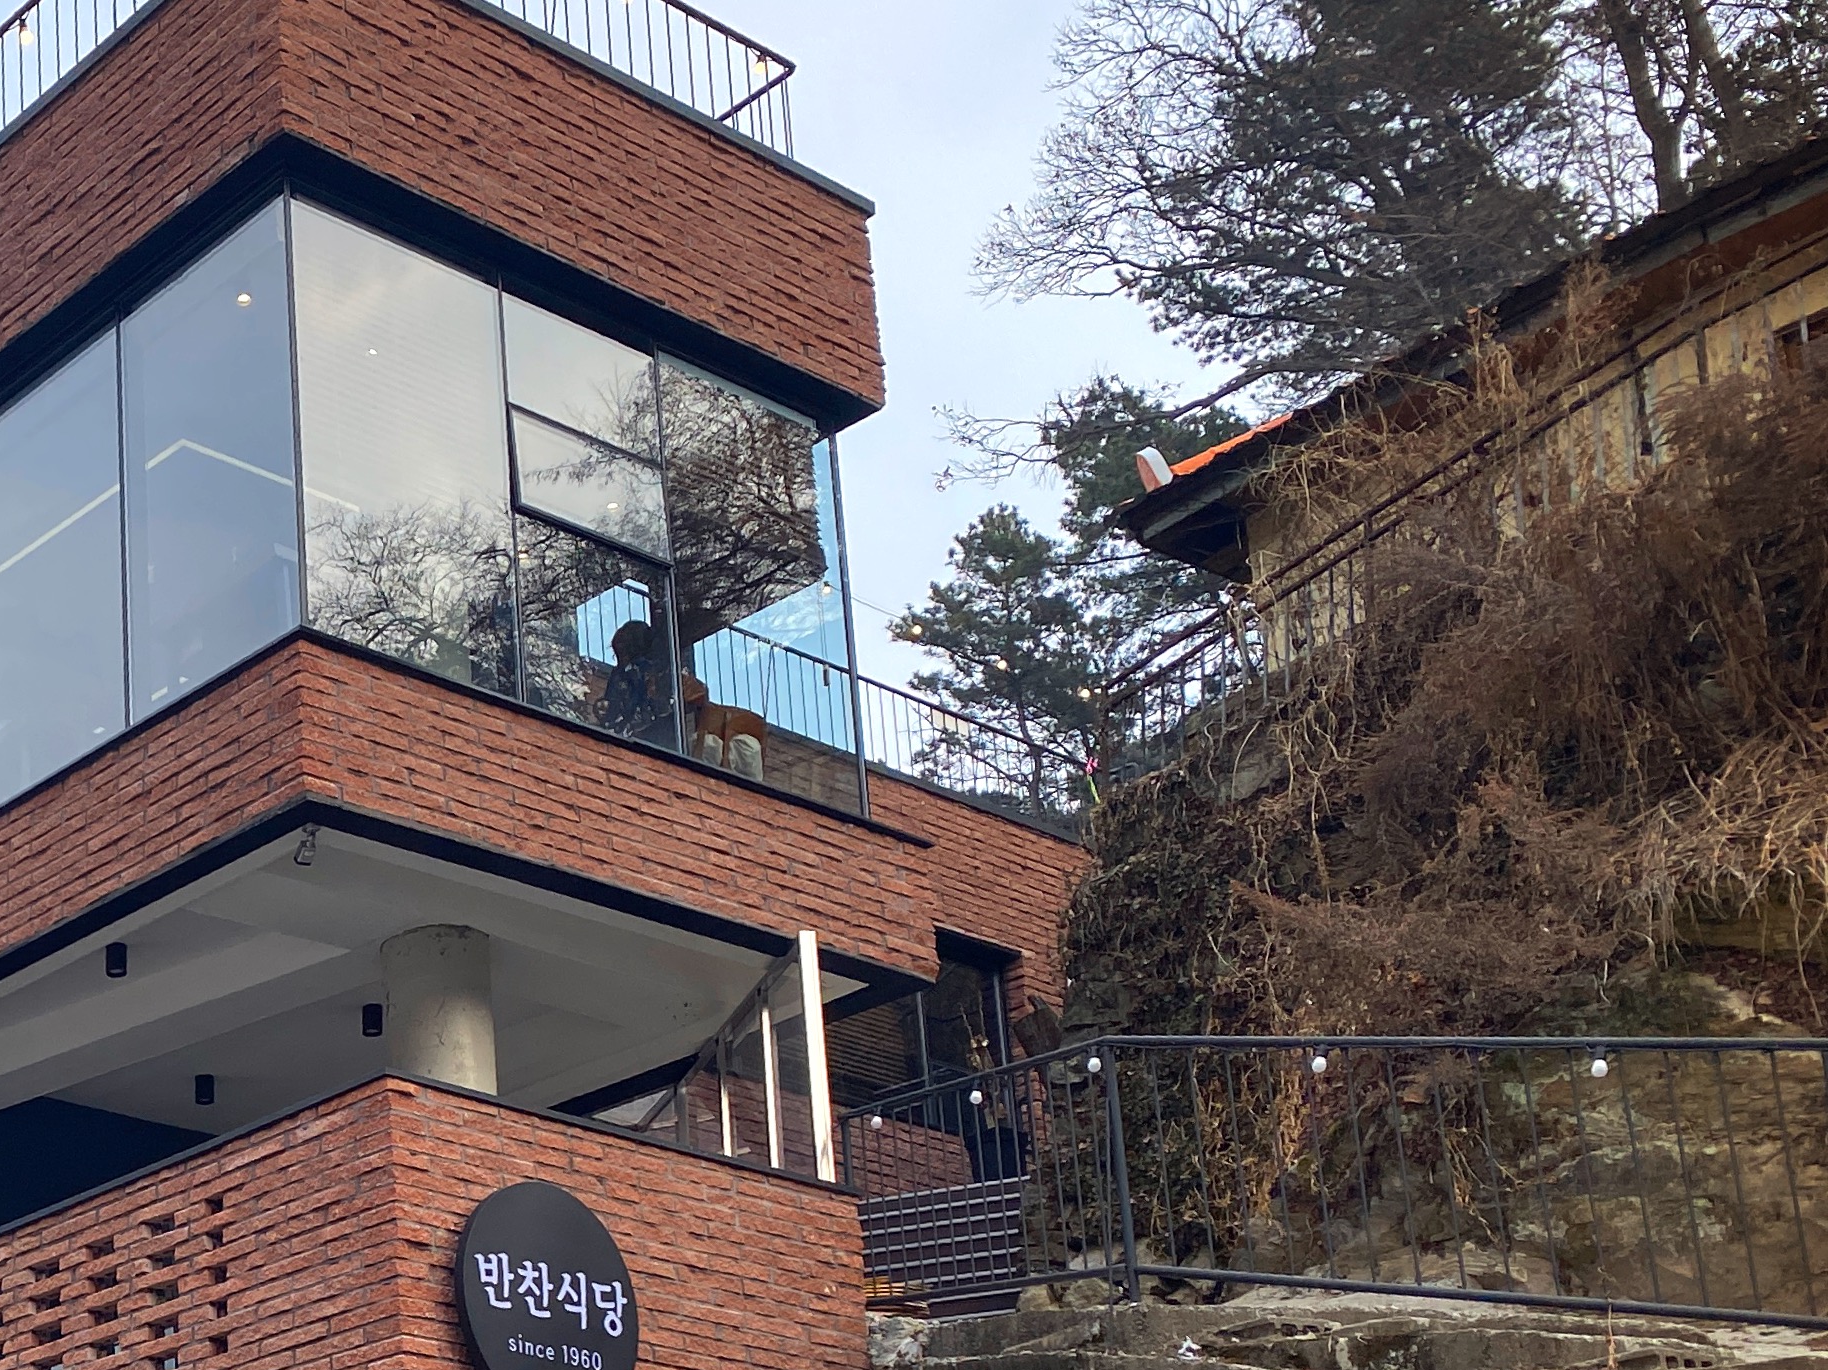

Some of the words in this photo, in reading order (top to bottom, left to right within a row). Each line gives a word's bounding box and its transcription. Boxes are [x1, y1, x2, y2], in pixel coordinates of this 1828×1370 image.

[473, 1252, 628, 1337] 반찬식당
[508, 1334, 555, 1361] since
[561, 1345, 603, 1370] 1960
